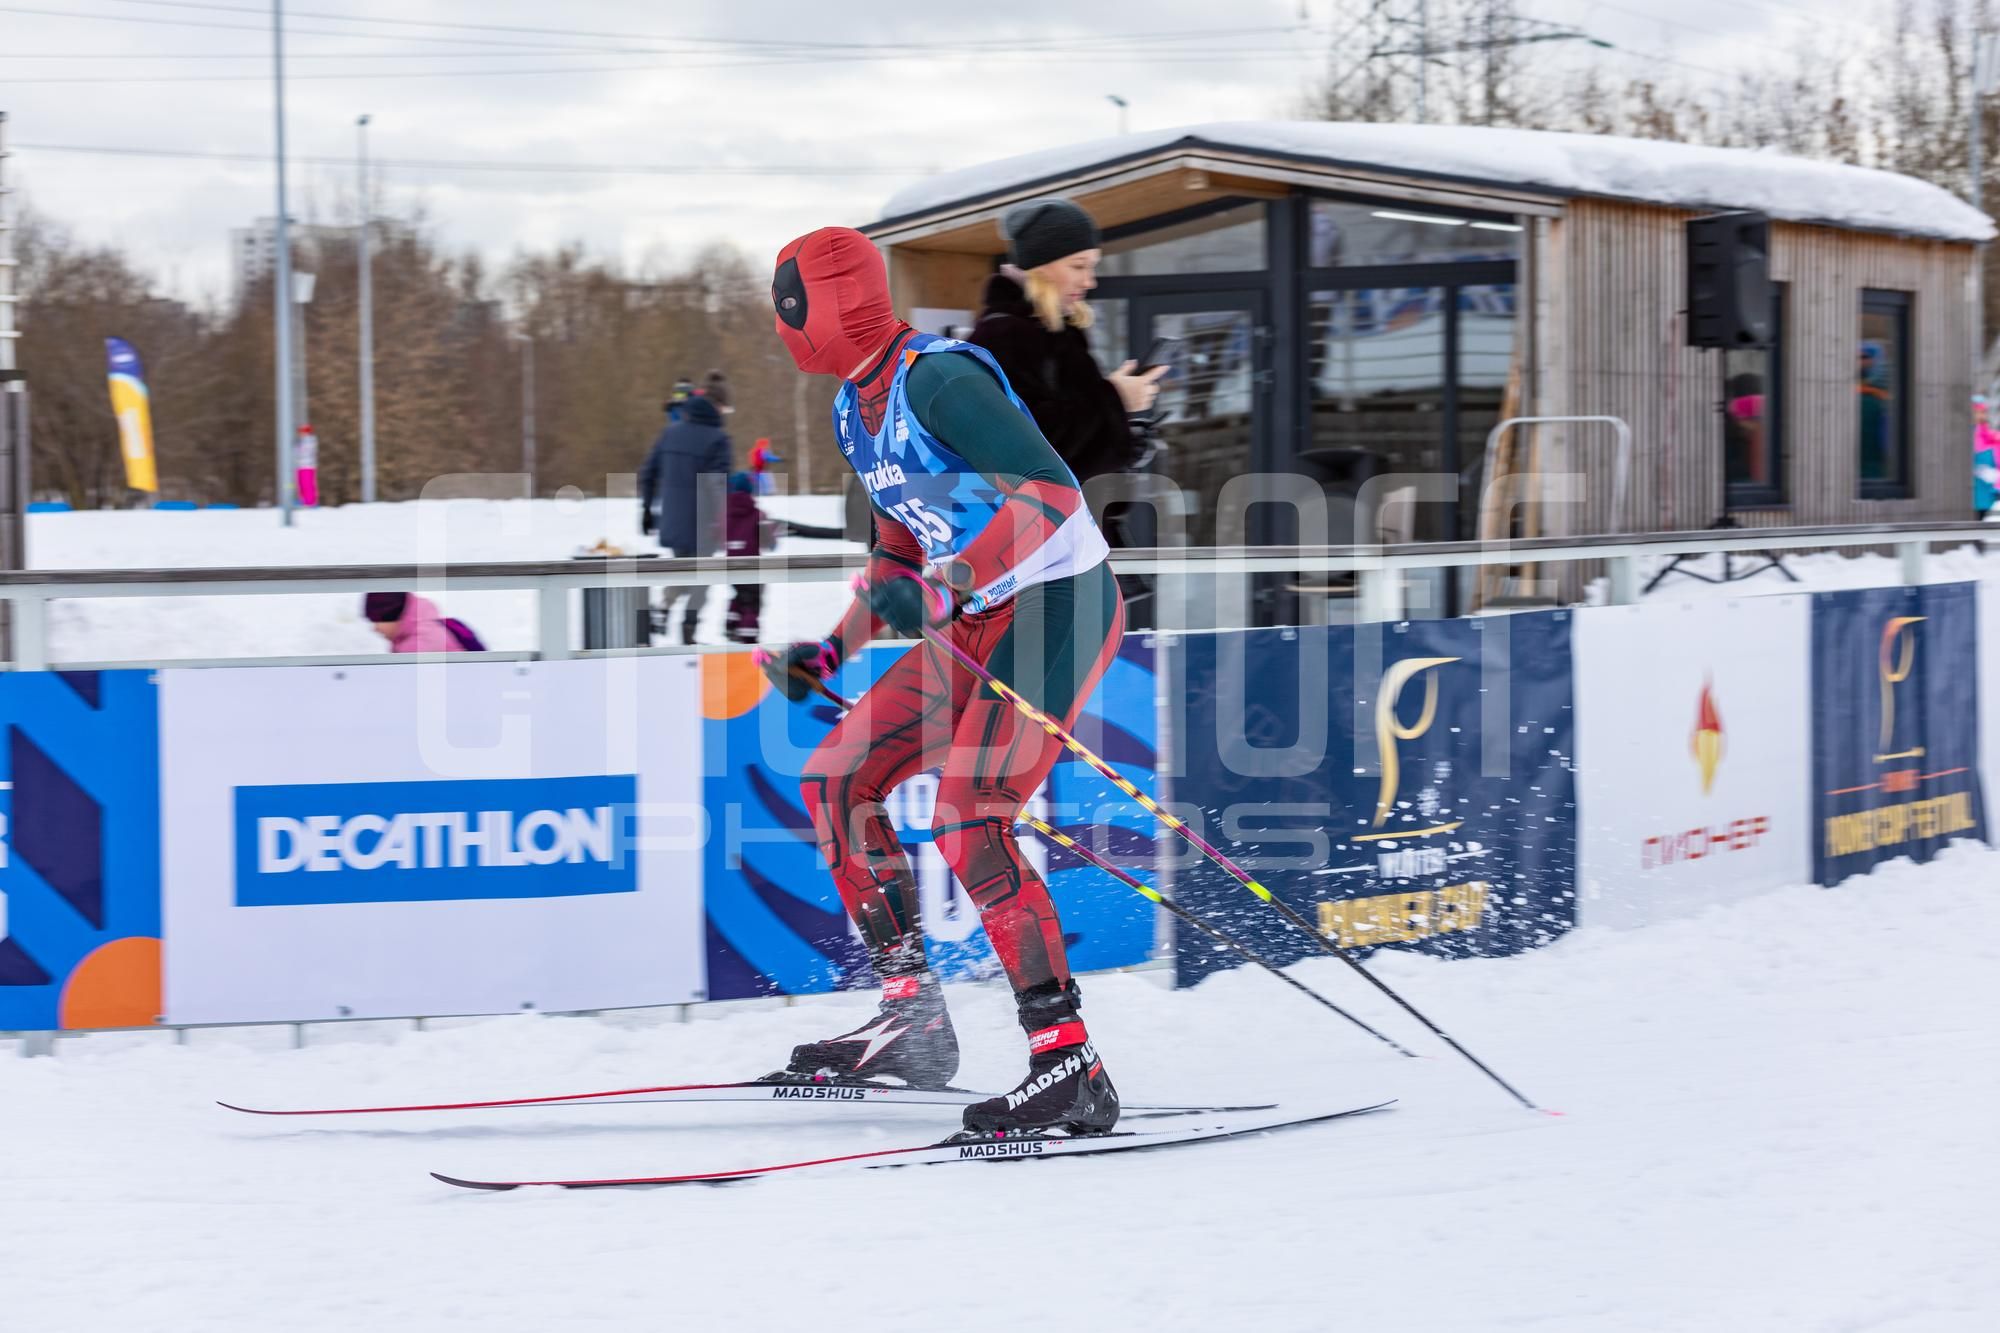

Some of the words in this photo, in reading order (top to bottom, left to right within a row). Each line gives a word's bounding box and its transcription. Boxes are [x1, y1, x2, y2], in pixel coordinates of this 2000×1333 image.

[864, 459, 907, 492] rukka
[987, 574, 1018, 598] РОДНЫЕ
[257, 805, 613, 874] DECATHLON
[772, 1087, 866, 1100] MADSHUS
[959, 1141, 1043, 1159] MADSHUS
